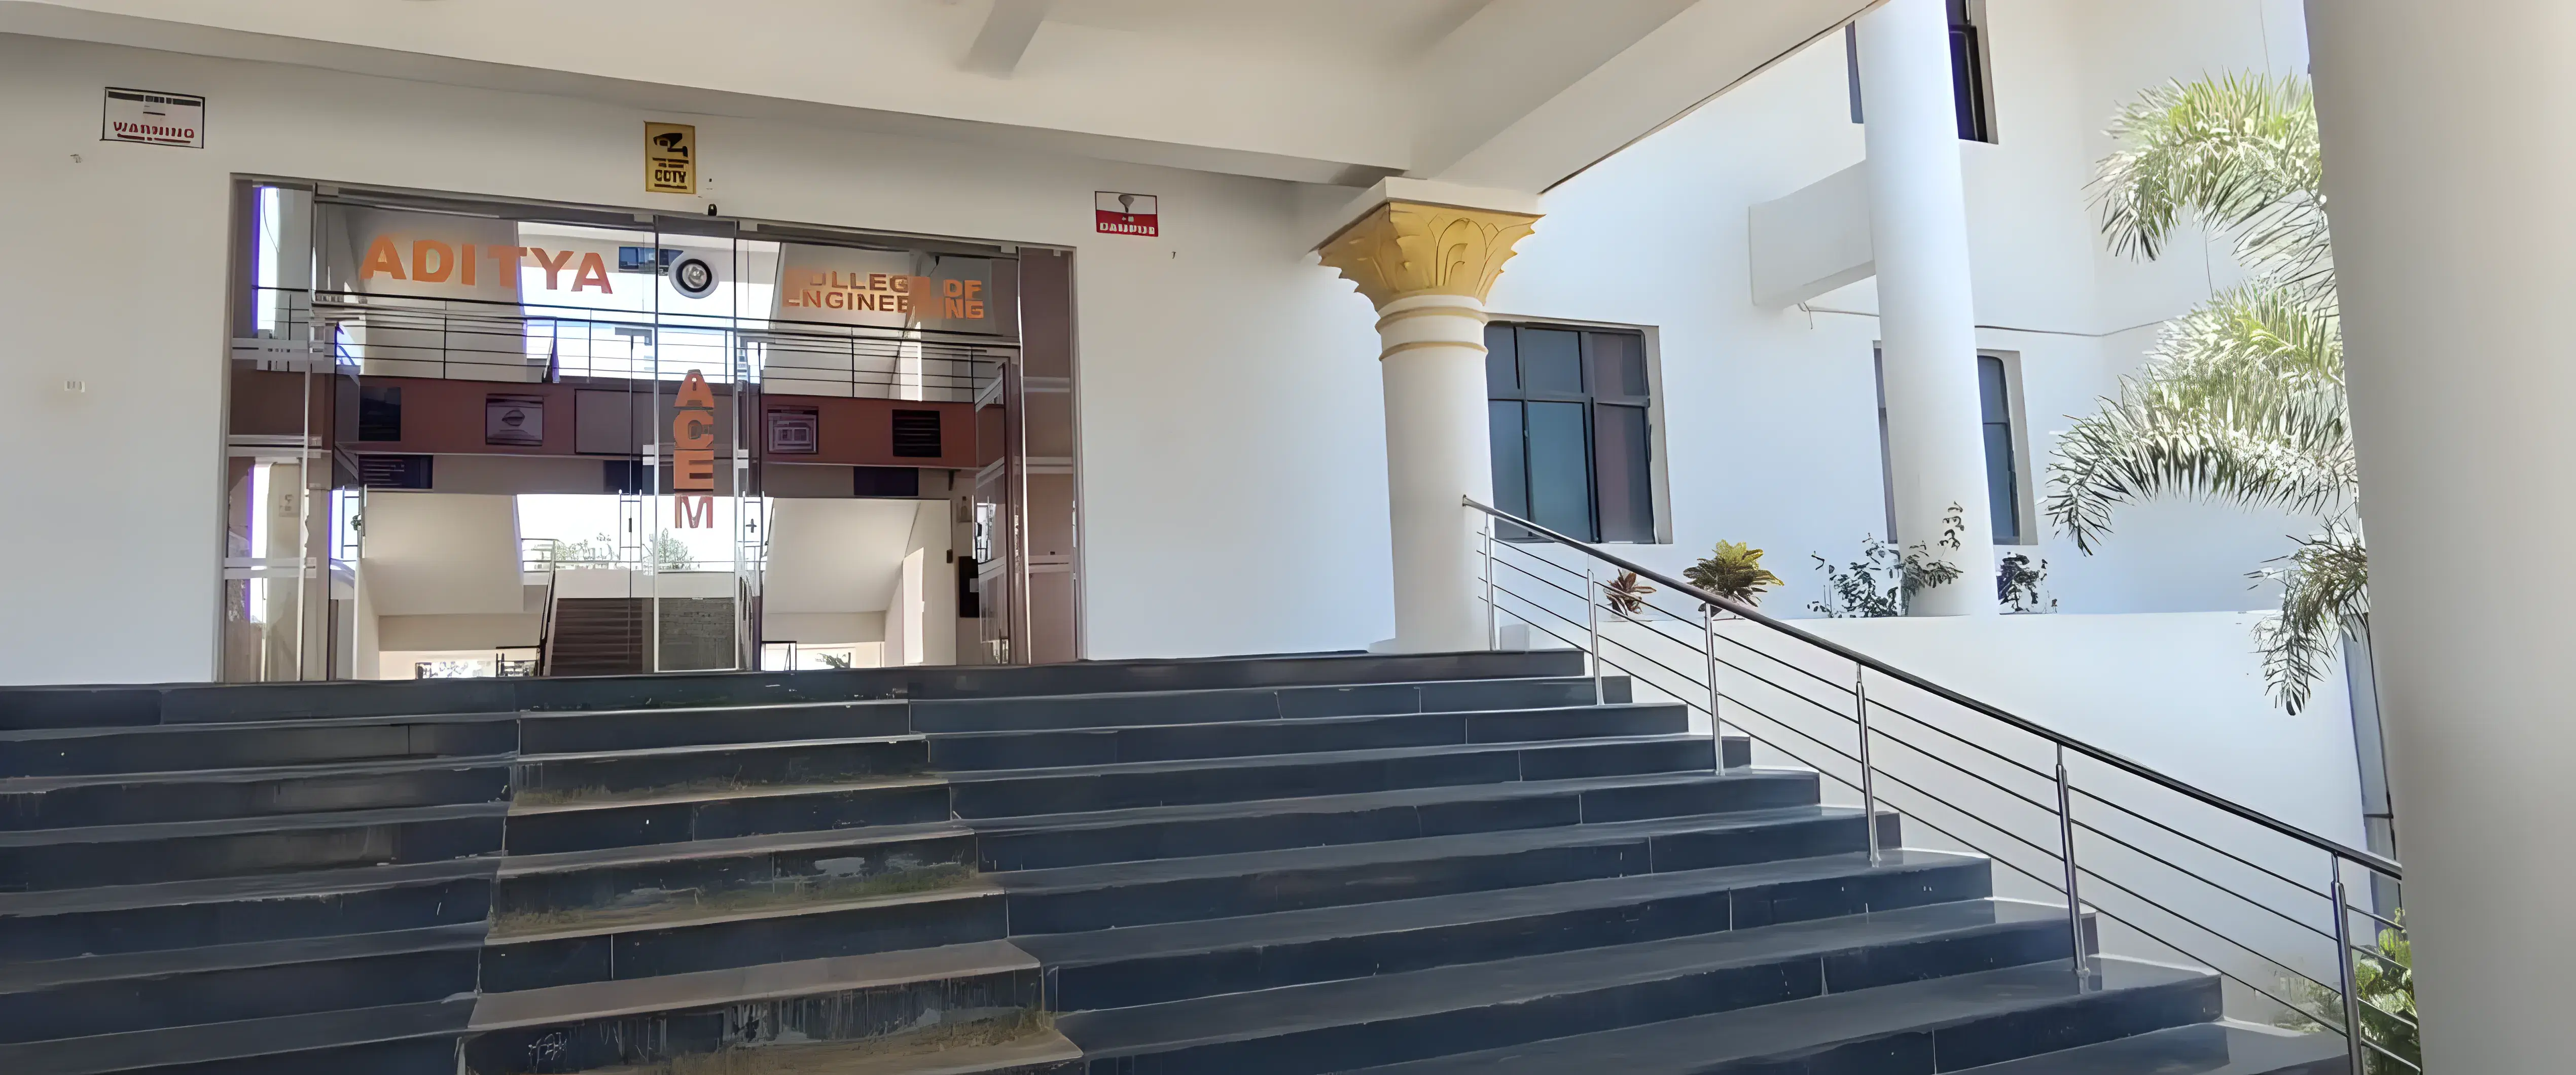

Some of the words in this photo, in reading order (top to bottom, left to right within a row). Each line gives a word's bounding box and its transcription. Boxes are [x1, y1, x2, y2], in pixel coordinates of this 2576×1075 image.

[360, 235, 613, 294] ADITYA
[783, 270, 932, 294] OLLEG
[782, 289, 984, 319] NGINEENG
[673, 369, 714, 528] ACEM
